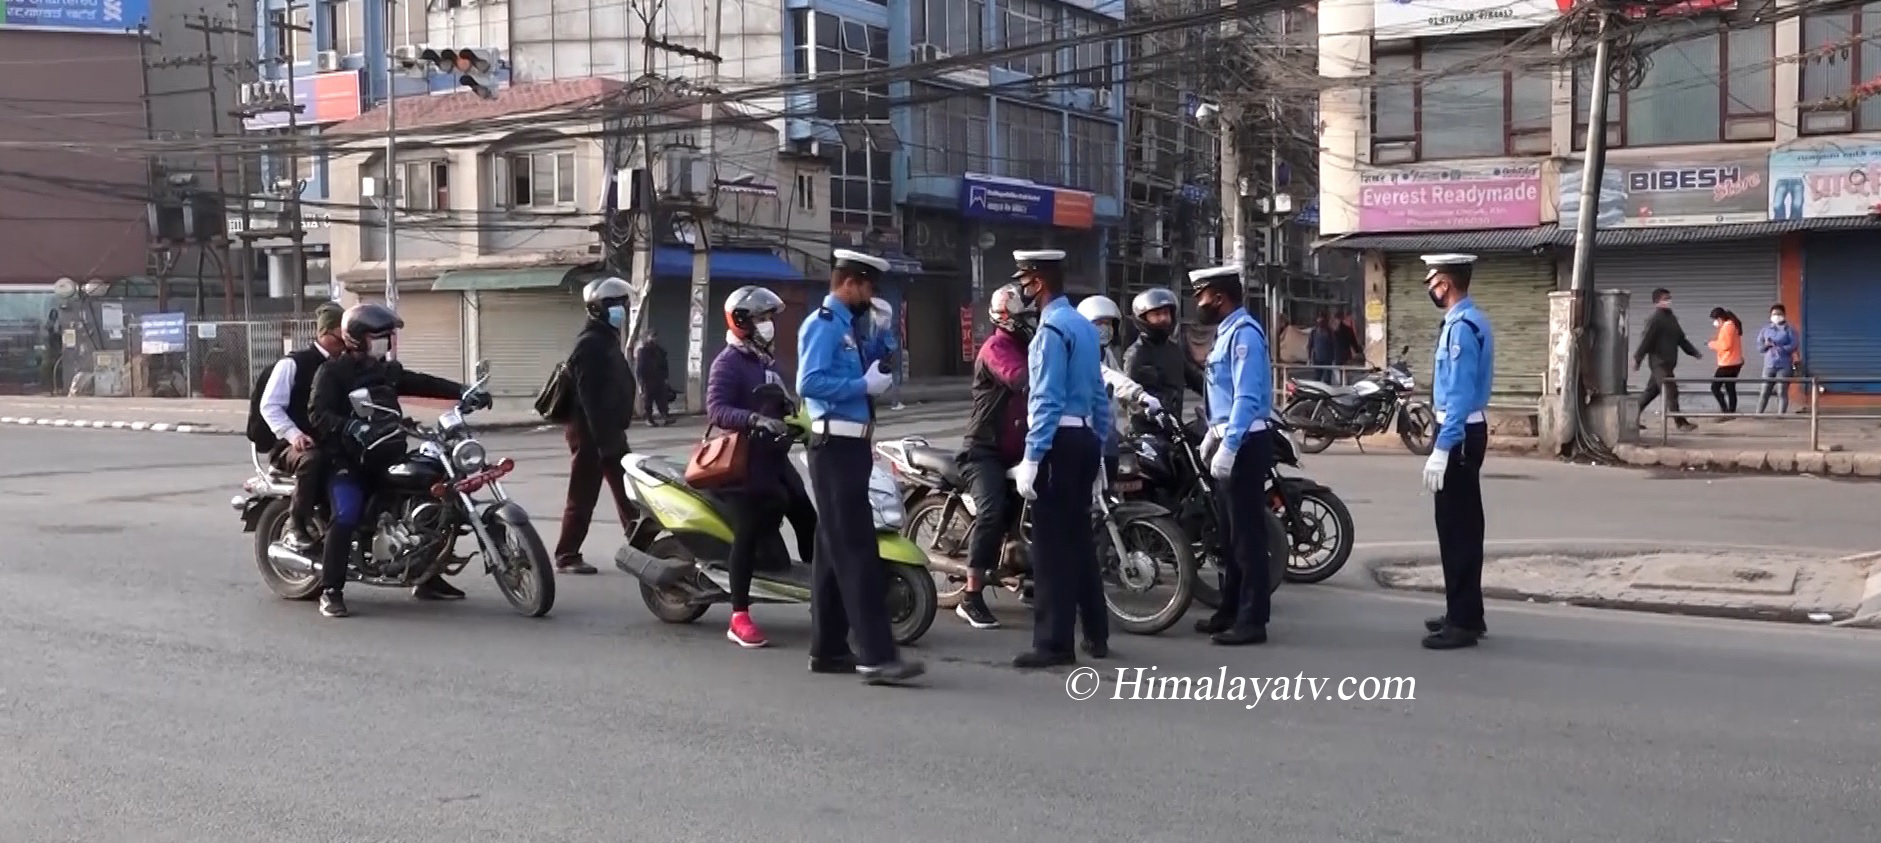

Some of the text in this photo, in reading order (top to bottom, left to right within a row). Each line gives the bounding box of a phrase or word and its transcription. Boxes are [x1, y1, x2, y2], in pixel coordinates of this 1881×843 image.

[1363, 182, 1537, 207] Everest Readymade
[1628, 166, 1761, 201] BIBESH Store
